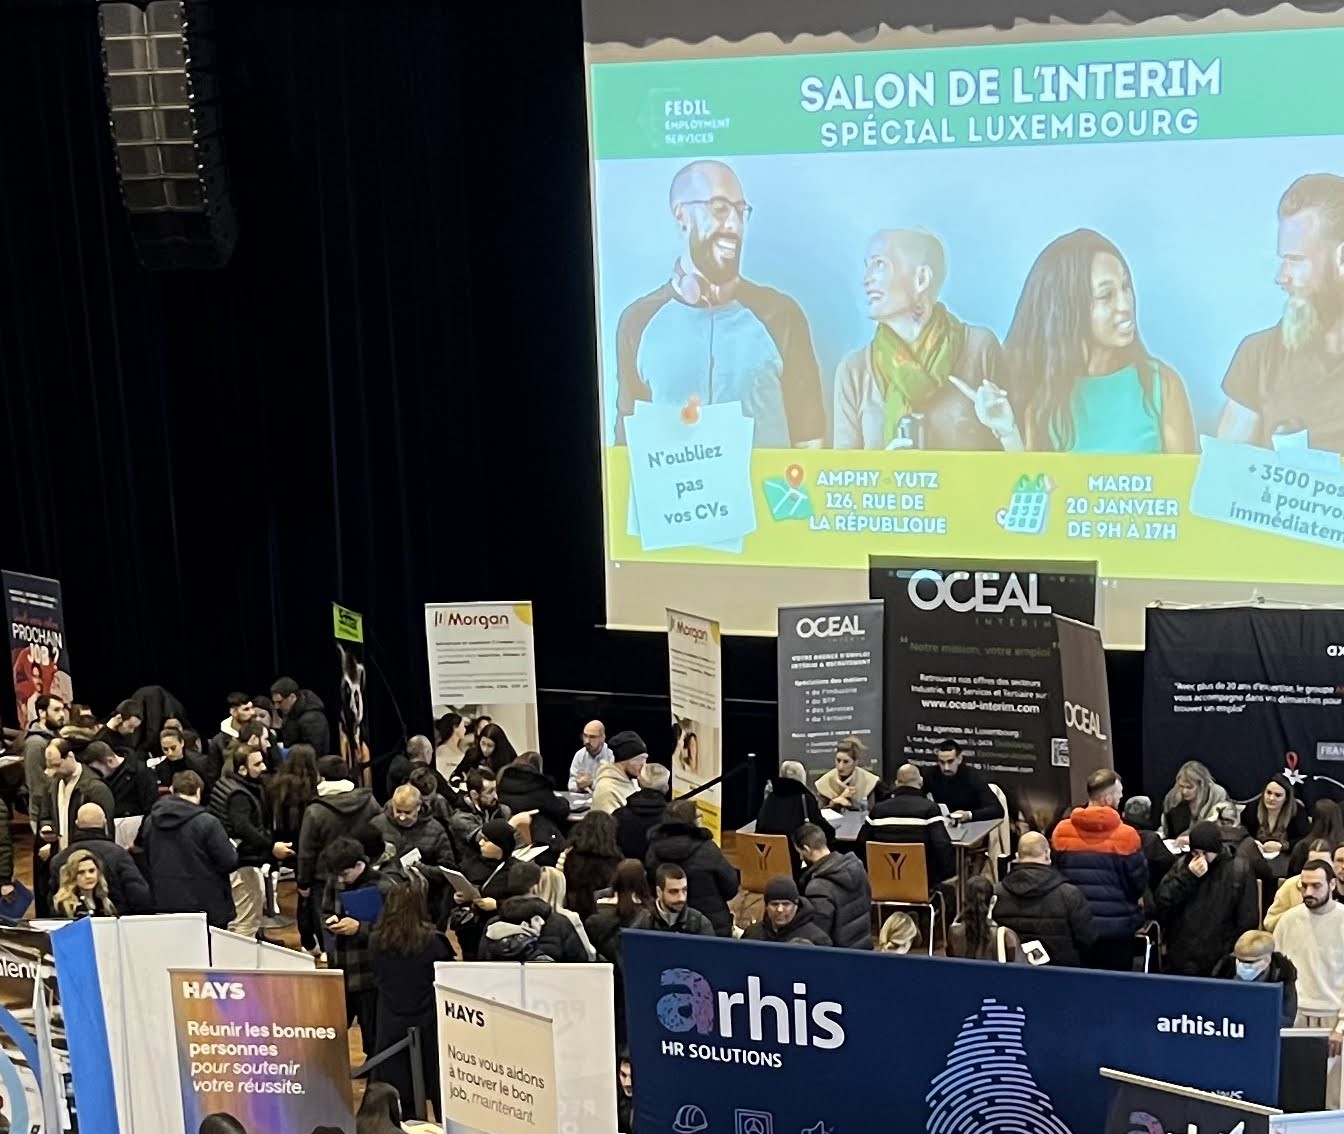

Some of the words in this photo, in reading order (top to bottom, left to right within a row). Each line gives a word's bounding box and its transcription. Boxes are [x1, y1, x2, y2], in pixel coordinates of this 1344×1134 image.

[799, 74, 936, 113] SALON
[949, 68, 1001, 107] DE
[1012, 58, 1222, 102] L'INTERIM
[664, 100, 711, 116] FEDIL
[664, 118, 731, 130] EMPLOYMENT
[820, 114, 955, 147] SPÉCIAL
[968, 108, 1199, 142] LUXEMBOURG
[665, 132, 714, 144] SERVICES
[648, 444, 722, 468] N'oubliez
[676, 478, 704, 497] pas
[816, 471, 879, 487] AMPHY
[893, 471, 938, 488] YUTZ
[1088, 475, 1152, 492] MARDI
[1248, 464, 1257, 474] +
[1261, 464, 1310, 489] 3500
[862, 494, 896, 509] RUE
[901, 495, 924, 510] DE
[1066, 498, 1089, 515] 20
[1093, 498, 1180, 516] JANVIER
[1261, 487, 1272, 504] à
[664, 510, 692, 524] vos
[695, 501, 729, 520] CVs
[809, 515, 830, 530] LA
[835, 511, 946, 534] RÉPUBLIQUE
[1068, 520, 1092, 538] DE
[1095, 520, 1119, 538] 9H
[1125, 517, 1140, 538] À
[1145, 522, 1176, 540] 17H
[907, 569, 1052, 614] OCEAL
[448, 613, 509, 629] Morgan
[676, 620, 708, 643] Morgan
[796, 615, 865, 638] OCEAL
[12, 622, 63, 650] PROCHAIN
[27, 642, 50, 666] JOB
[52, 647, 60, 670] ?
[921, 699, 1040, 713] www.oceal-interim.com
[1064, 700, 1107, 740] OCEAL
[182, 981, 245, 1000] HAYS
[445, 1000, 485, 1028] HAYS
[656, 967, 846, 1051] arhis
[187, 1020, 242, 1037] Réunir
[245, 1022, 269, 1037] les
[272, 1023, 336, 1039] bonnes
[1156, 1012, 1245, 1038] arhis.lu
[190, 1043, 278, 1058] personnes
[661, 1041, 685, 1058] HR
[688, 1043, 783, 1069] SOLUTIONS
[191, 1061, 231, 1077] pour
[233, 1060, 300, 1075] soutenir
[448, 1043, 476, 1066] Nous
[479, 1057, 504, 1076] vous
[506, 1065, 545, 1089] aidons
[193, 1079, 234, 1092] votre
[238, 1078, 305, 1094] réussite.
[449, 1063, 455, 1078] à
[457, 1067, 497, 1092] trouver
[499, 1080, 509, 1097] le
[512, 1085, 533, 1106] bon
[450, 1082, 470, 1103] job,
[472, 1093, 536, 1125] maintenant.
